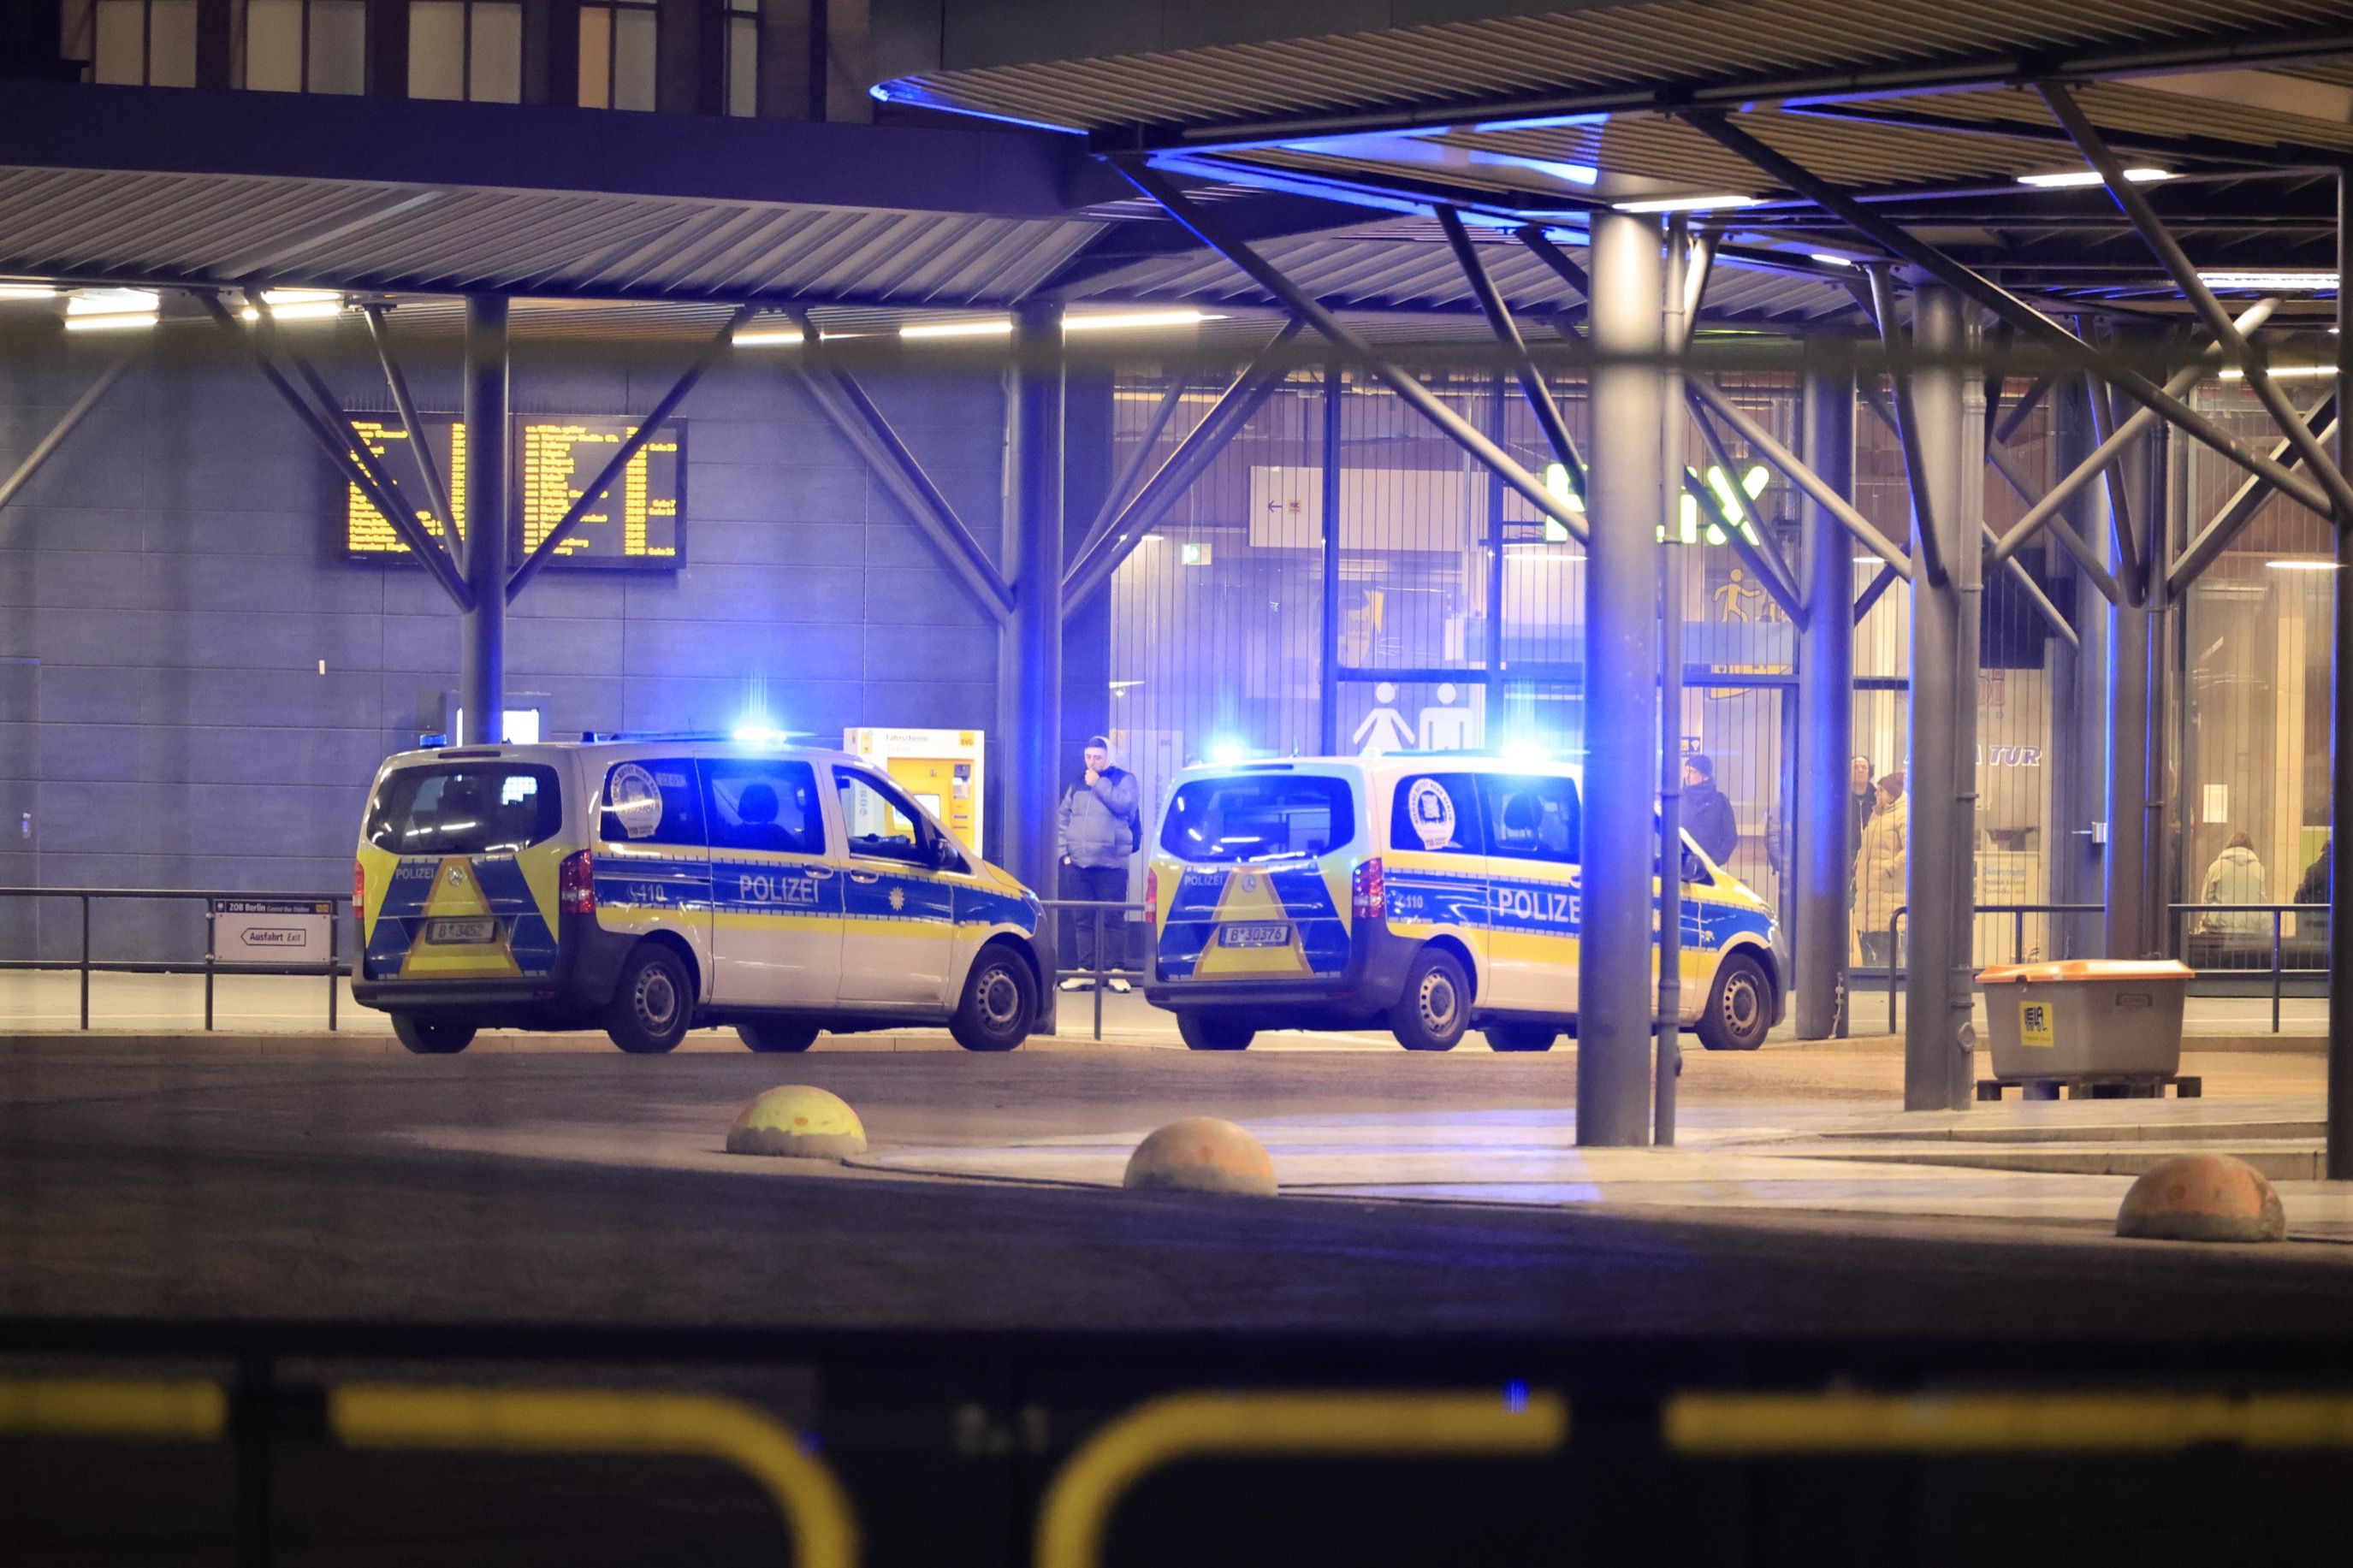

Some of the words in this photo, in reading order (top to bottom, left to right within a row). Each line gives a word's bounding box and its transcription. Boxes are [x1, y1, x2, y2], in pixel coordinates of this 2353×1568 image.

[961, 738, 974, 747] BVG
[1989, 745, 2043, 767] TUR
[396, 867, 435, 880] POLIZEI
[1184, 874, 1224, 886] POLIZEI
[739, 874, 821, 904] POLIZEI
[229, 902, 244, 912] ZOB
[245, 902, 266, 912] Berlin
[1406, 895, 1424, 908] 110
[1498, 889, 1581, 924] POLIZE
[250, 932, 283, 942] Ausfahrt
[287, 932, 301, 942] Exit
